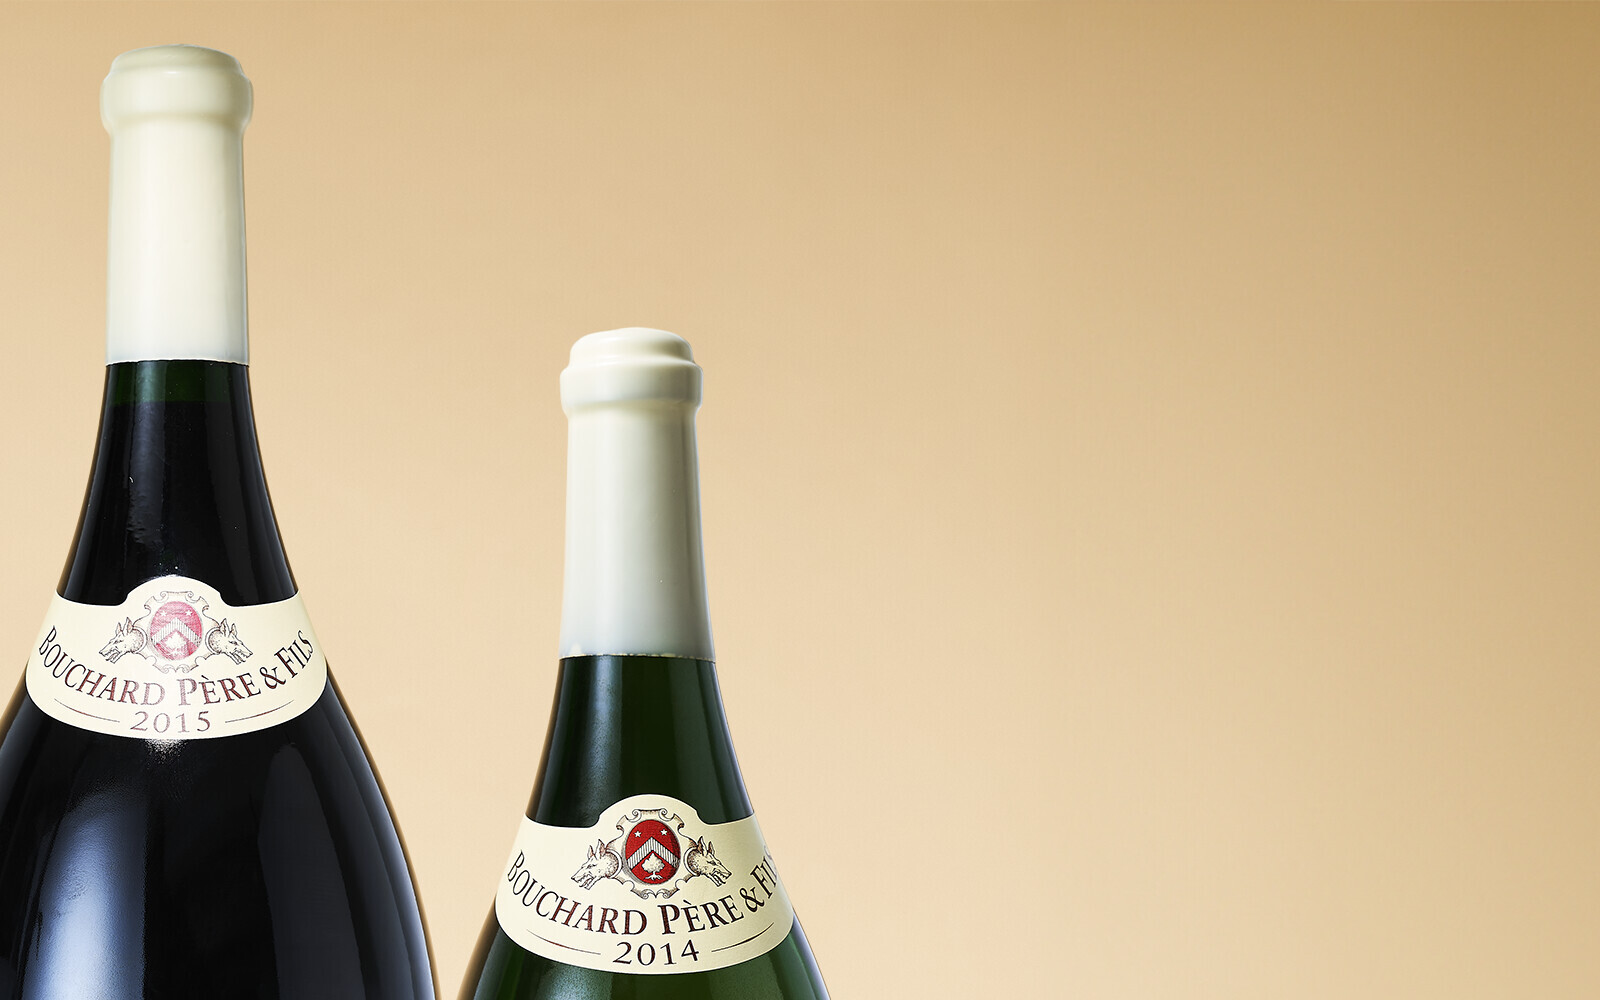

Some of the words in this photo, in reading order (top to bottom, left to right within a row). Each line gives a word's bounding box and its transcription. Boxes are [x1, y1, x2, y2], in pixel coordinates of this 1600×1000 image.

[38, 625, 166, 707] BOUCHARD
[176, 672, 262, 707] PÈRE
[259, 666, 287, 690] &
[274, 629, 315, 679] FILS
[130, 711, 211, 734] 2015
[507, 850, 647, 936] BOUCHARD
[658, 899, 744, 936] PÈRE
[739, 887, 765, 912] &
[612, 939, 700, 966] 2014
